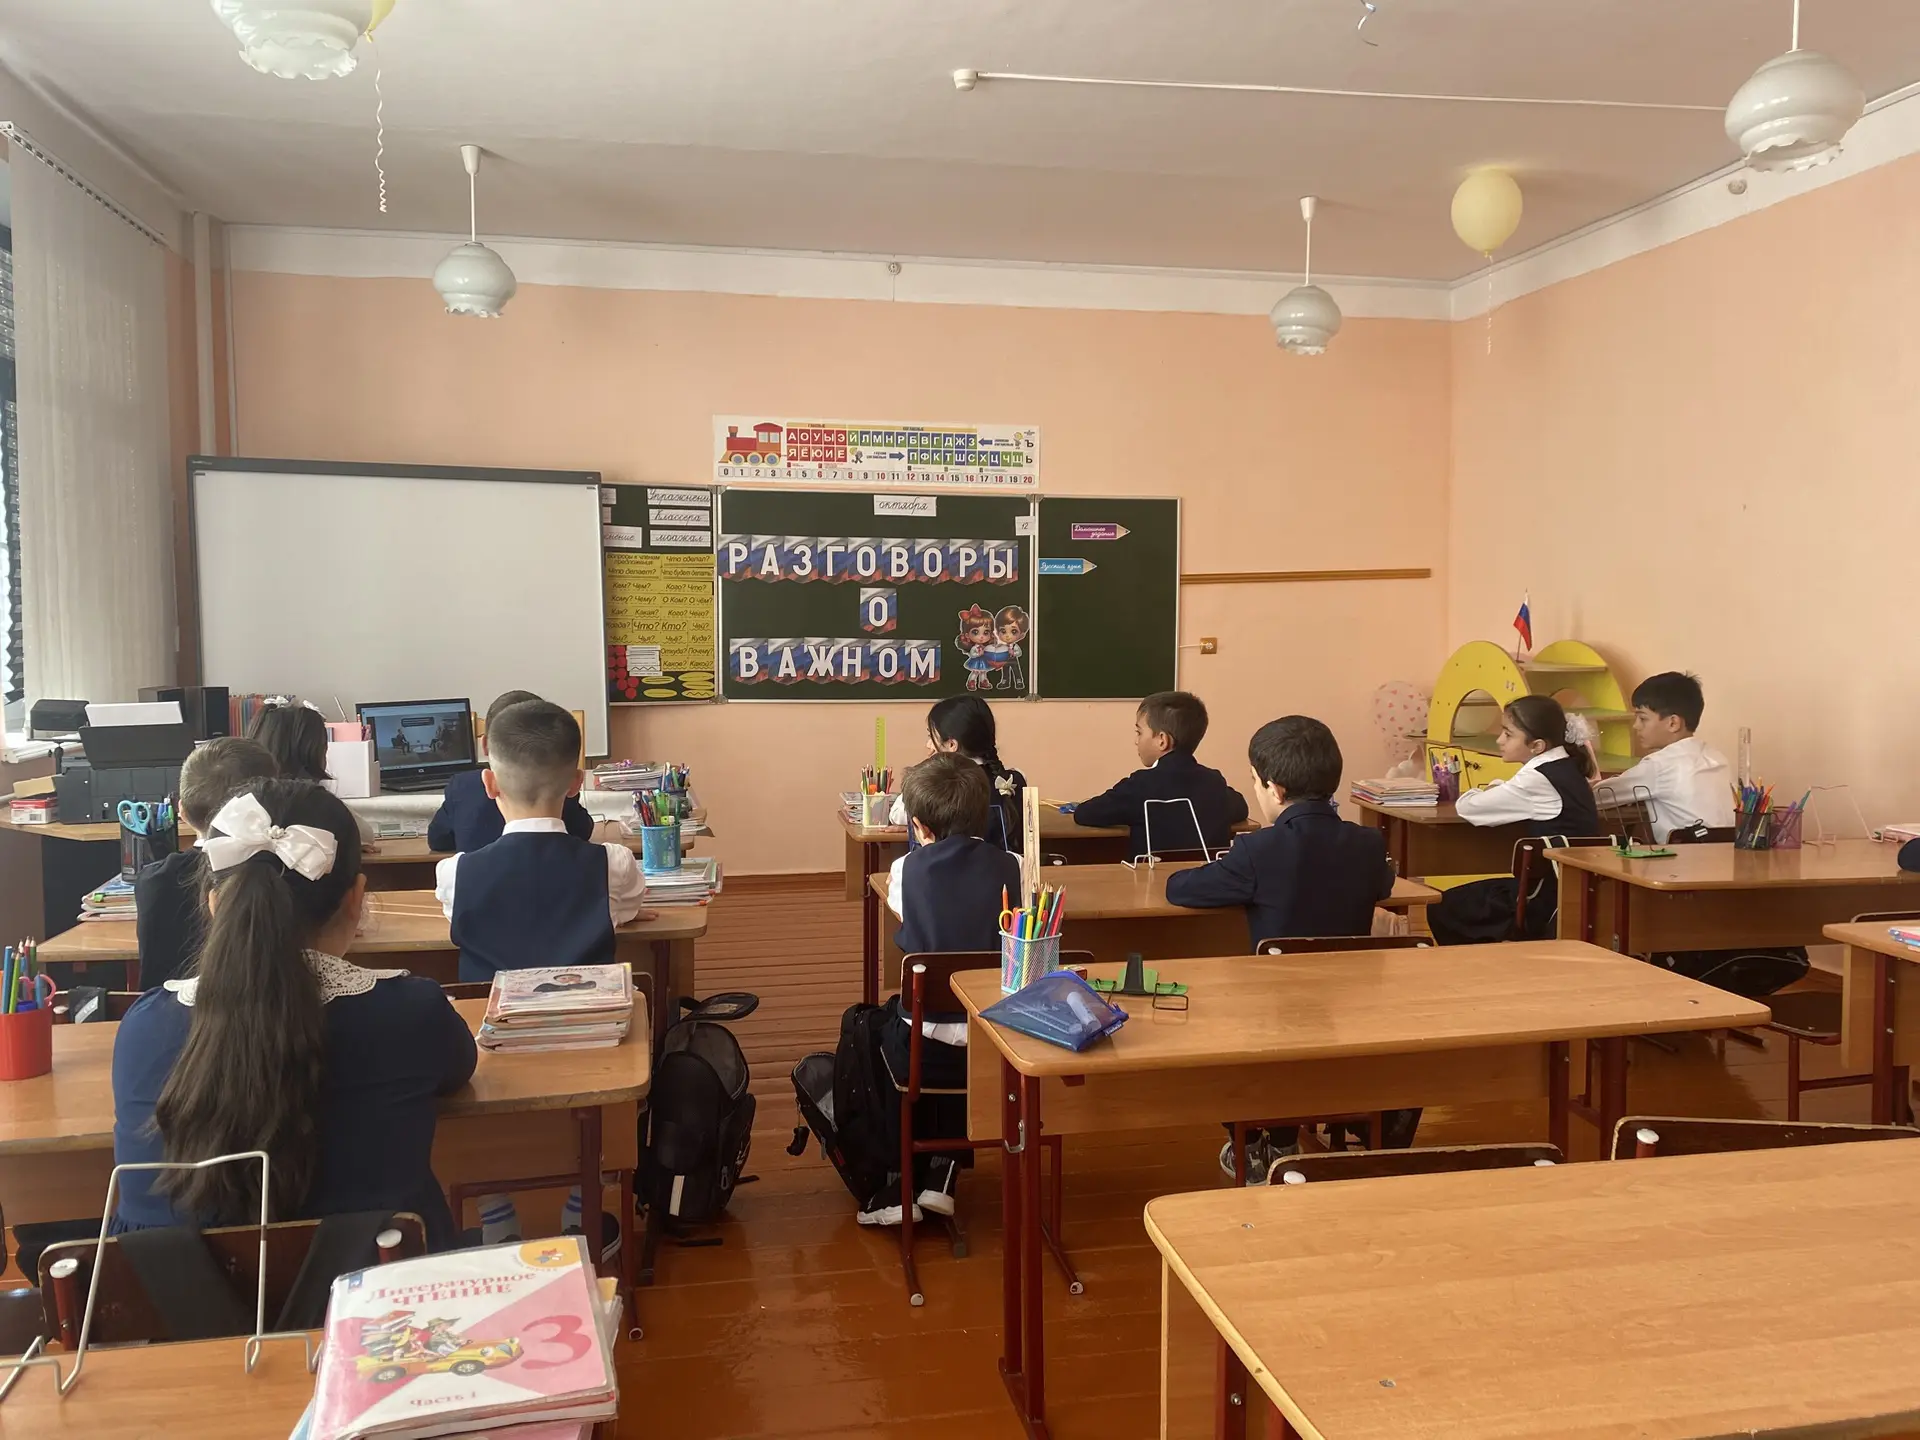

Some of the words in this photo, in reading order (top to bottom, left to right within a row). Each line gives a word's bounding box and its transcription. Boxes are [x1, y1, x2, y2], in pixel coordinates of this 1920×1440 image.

[1025, 439, 1034, 448] Ъ
[1026, 455, 1033, 464] Ь
[723, 468, 729, 476] 0
[740, 468, 744, 476] 1
[755, 469, 761, 477] 2
[771, 469, 776, 477] 3
[786, 469, 792, 477] 4
[801, 470, 807, 478] 5
[817, 470, 823, 478] 6
[832, 470, 838, 478] 7
[848, 471, 853, 479] 8
[863, 471, 868, 479] 9
[877, 472, 886, 480] 10
[892, 472, 900, 480] 11
[907, 472, 915, 480] 12
[921, 473, 930, 481] 13
[936, 473, 945, 481] 14
[966, 474, 974, 482] 16
[980, 474, 989, 482] 17
[995, 475, 1004, 483] 18
[1009, 475, 1018, 483] 19
[1023, 475, 1033, 483] 20
[879, 496, 928, 515] октября
[728, 542, 1013, 579] РАЗГОВОРЫ
[688, 596, 695, 604] О
[869, 596, 888, 627] О
[633, 621, 660, 630] Что?
[661, 621, 687, 630] Кто?
[691, 634, 711, 642] Куда?
[739, 646, 936, 678] ВАЖНОМ
[365, 1272, 537, 1304] Литературное
[392, 1284, 513, 1306] ЧТЕНИЕ
[521, 1314, 593, 1370] 3
[410, 1394, 465, 1407] Часть
